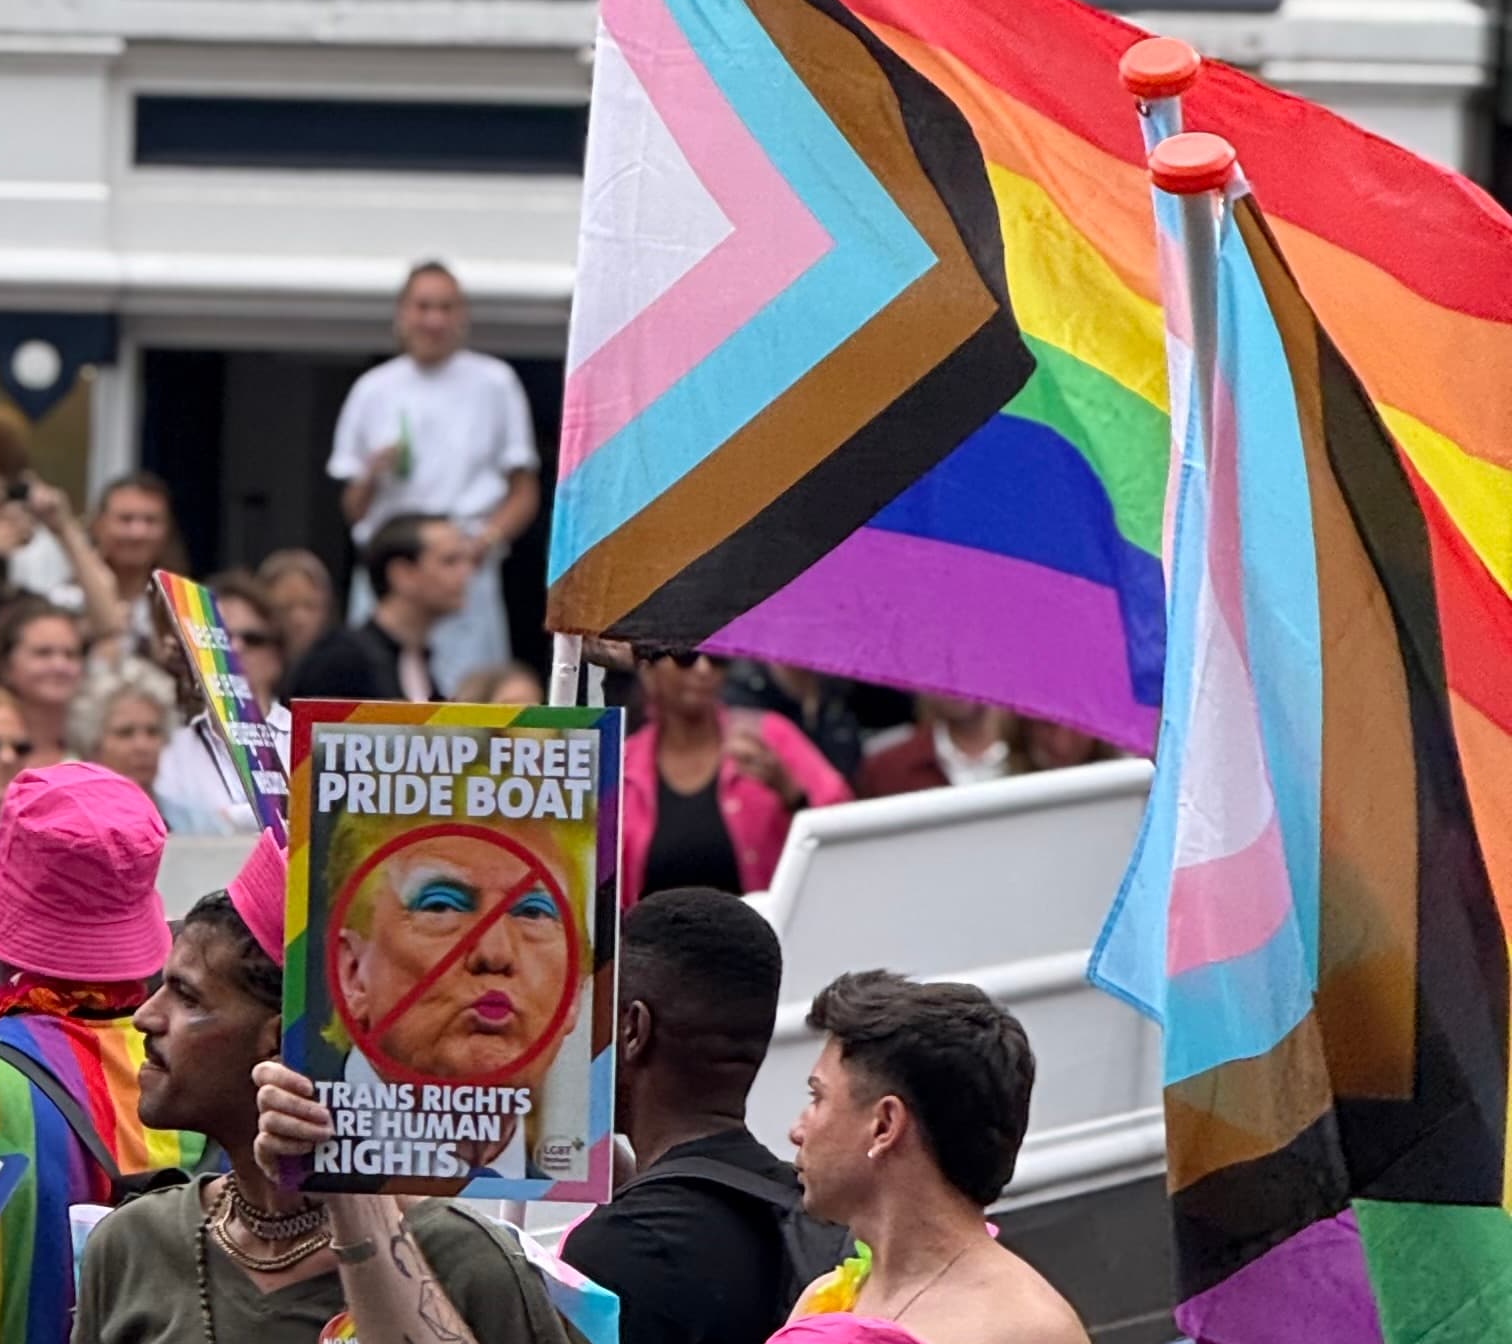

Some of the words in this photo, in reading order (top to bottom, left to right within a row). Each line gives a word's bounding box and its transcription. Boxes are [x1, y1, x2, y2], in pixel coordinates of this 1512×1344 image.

[318, 733, 478, 774] TRUMP
[489, 737, 591, 777] FREE
[318, 773, 453, 816] PRIDE
[466, 776, 593, 820] BOAT
[314, 1081, 414, 1111] TRANS
[422, 1084, 532, 1115] RIGHTS
[333, 1109, 373, 1138] RE
[380, 1111, 501, 1142] HUMAN
[314, 1138, 459, 1178] RIGHTS
